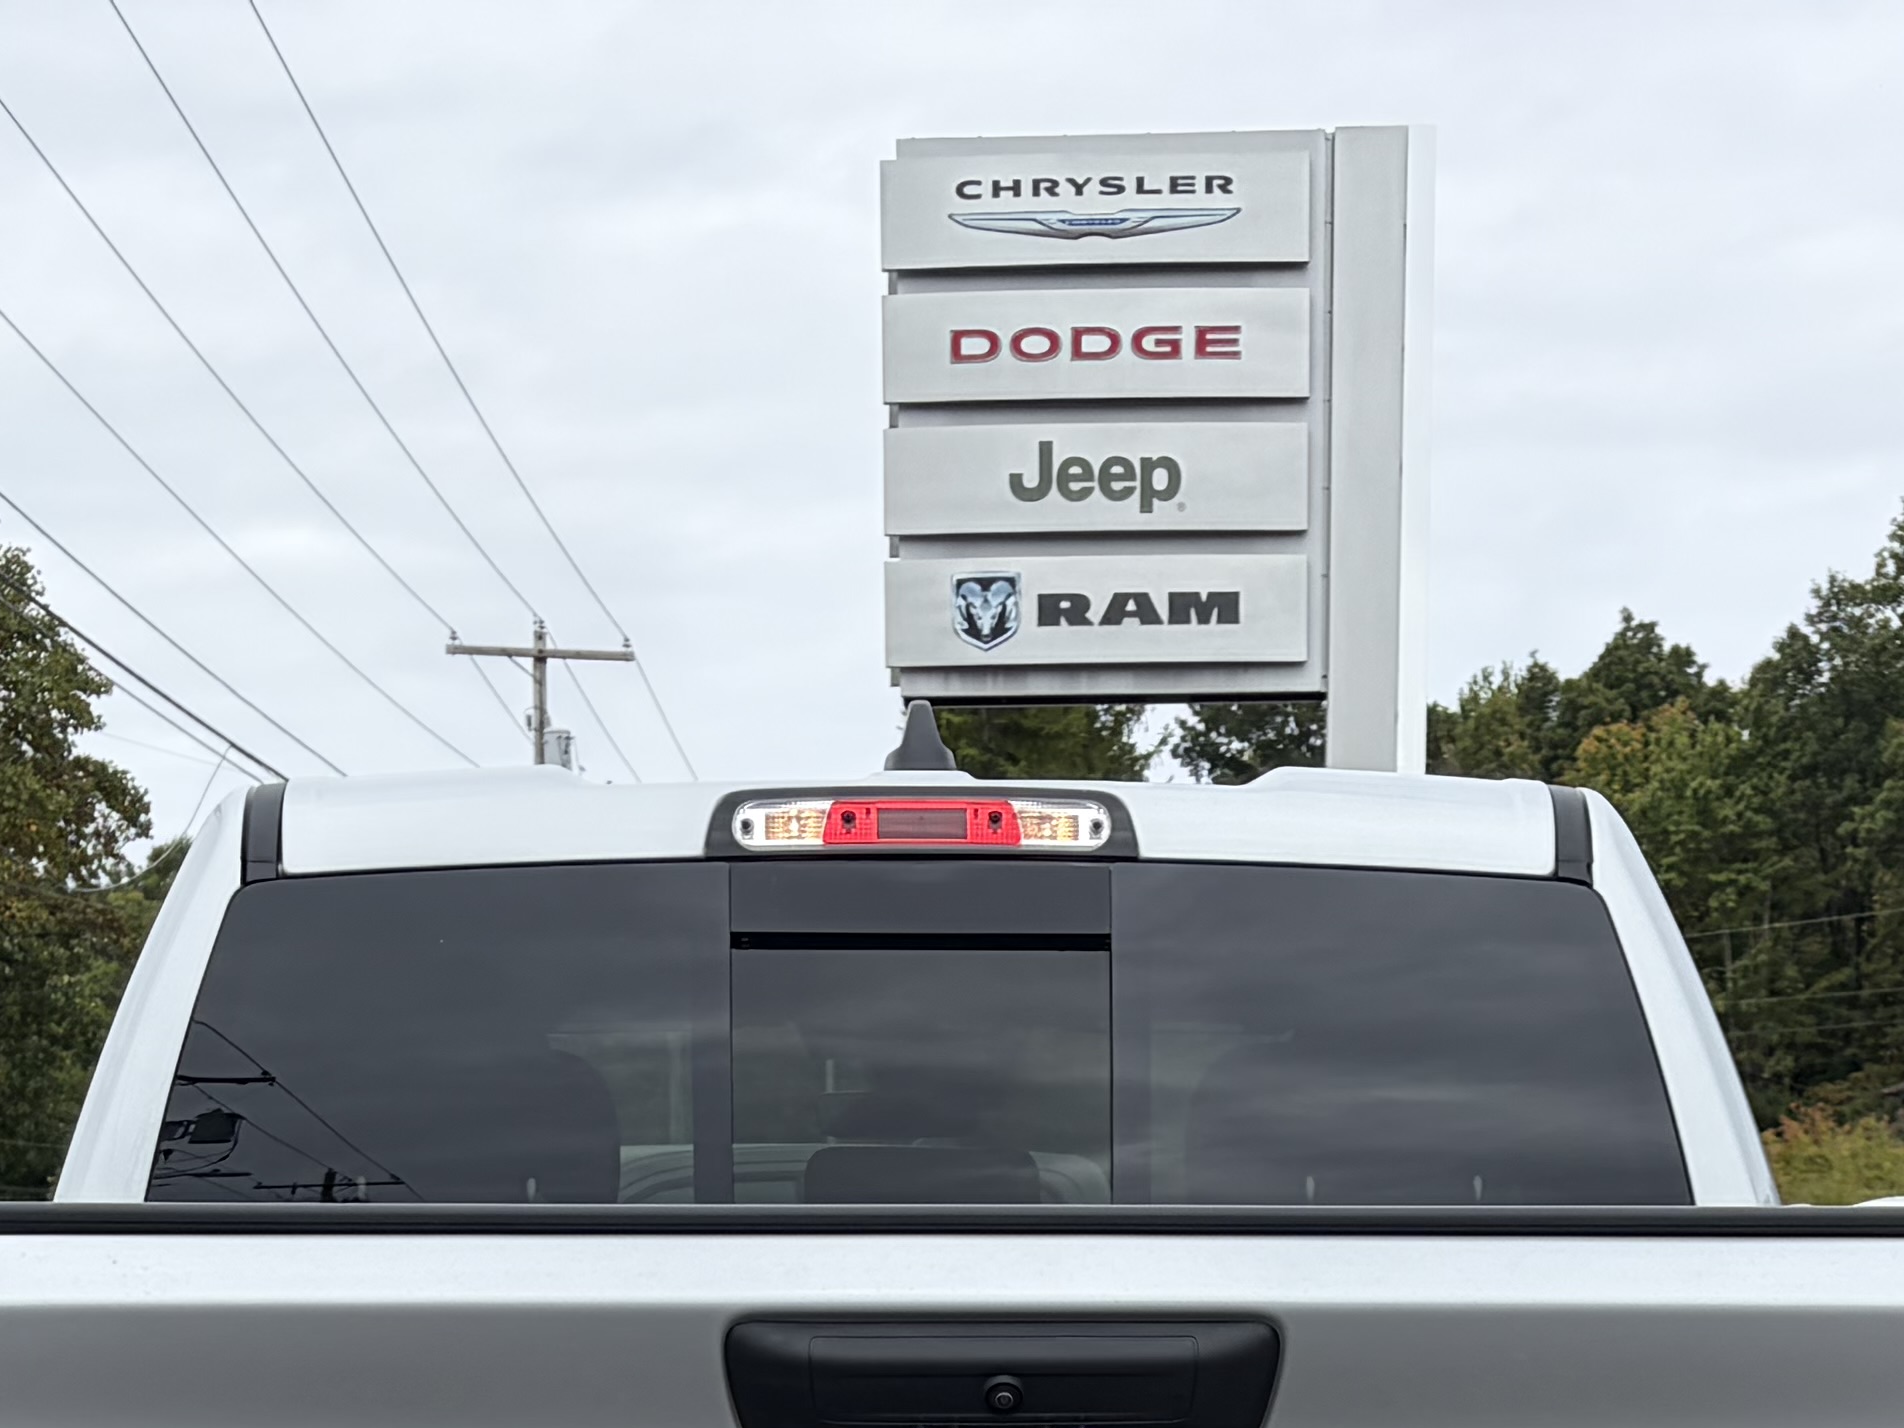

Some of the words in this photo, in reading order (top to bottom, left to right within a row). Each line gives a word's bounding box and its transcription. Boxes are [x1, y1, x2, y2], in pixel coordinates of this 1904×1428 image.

[955, 174, 1235, 200] CHRYSLER
[949, 325, 1242, 364] DODGE
[1008, 440, 1182, 513] Jeep
[1037, 591, 1241, 627] RAM
